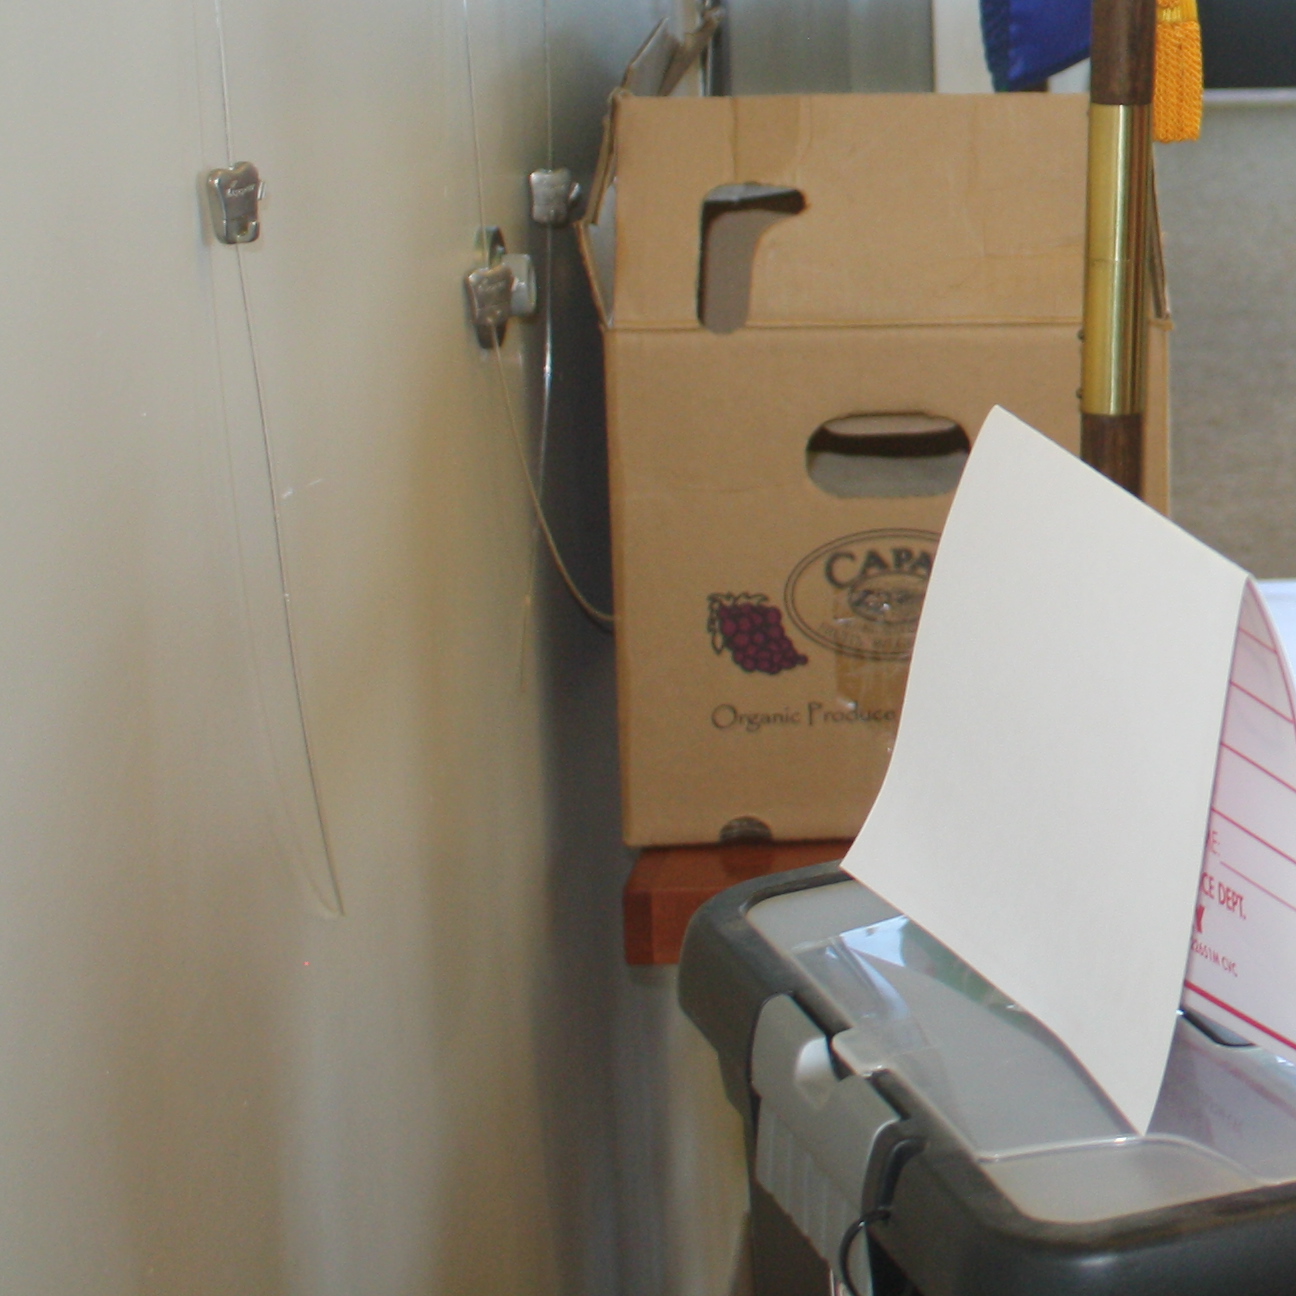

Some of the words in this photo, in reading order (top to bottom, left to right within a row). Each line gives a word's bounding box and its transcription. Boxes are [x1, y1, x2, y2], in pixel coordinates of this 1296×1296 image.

[824, 547, 933, 589] CAPA
[711, 703, 801, 733] Organic
[807, 700, 897, 726] Produce
[1218, 881, 1247, 920] DEPT.
